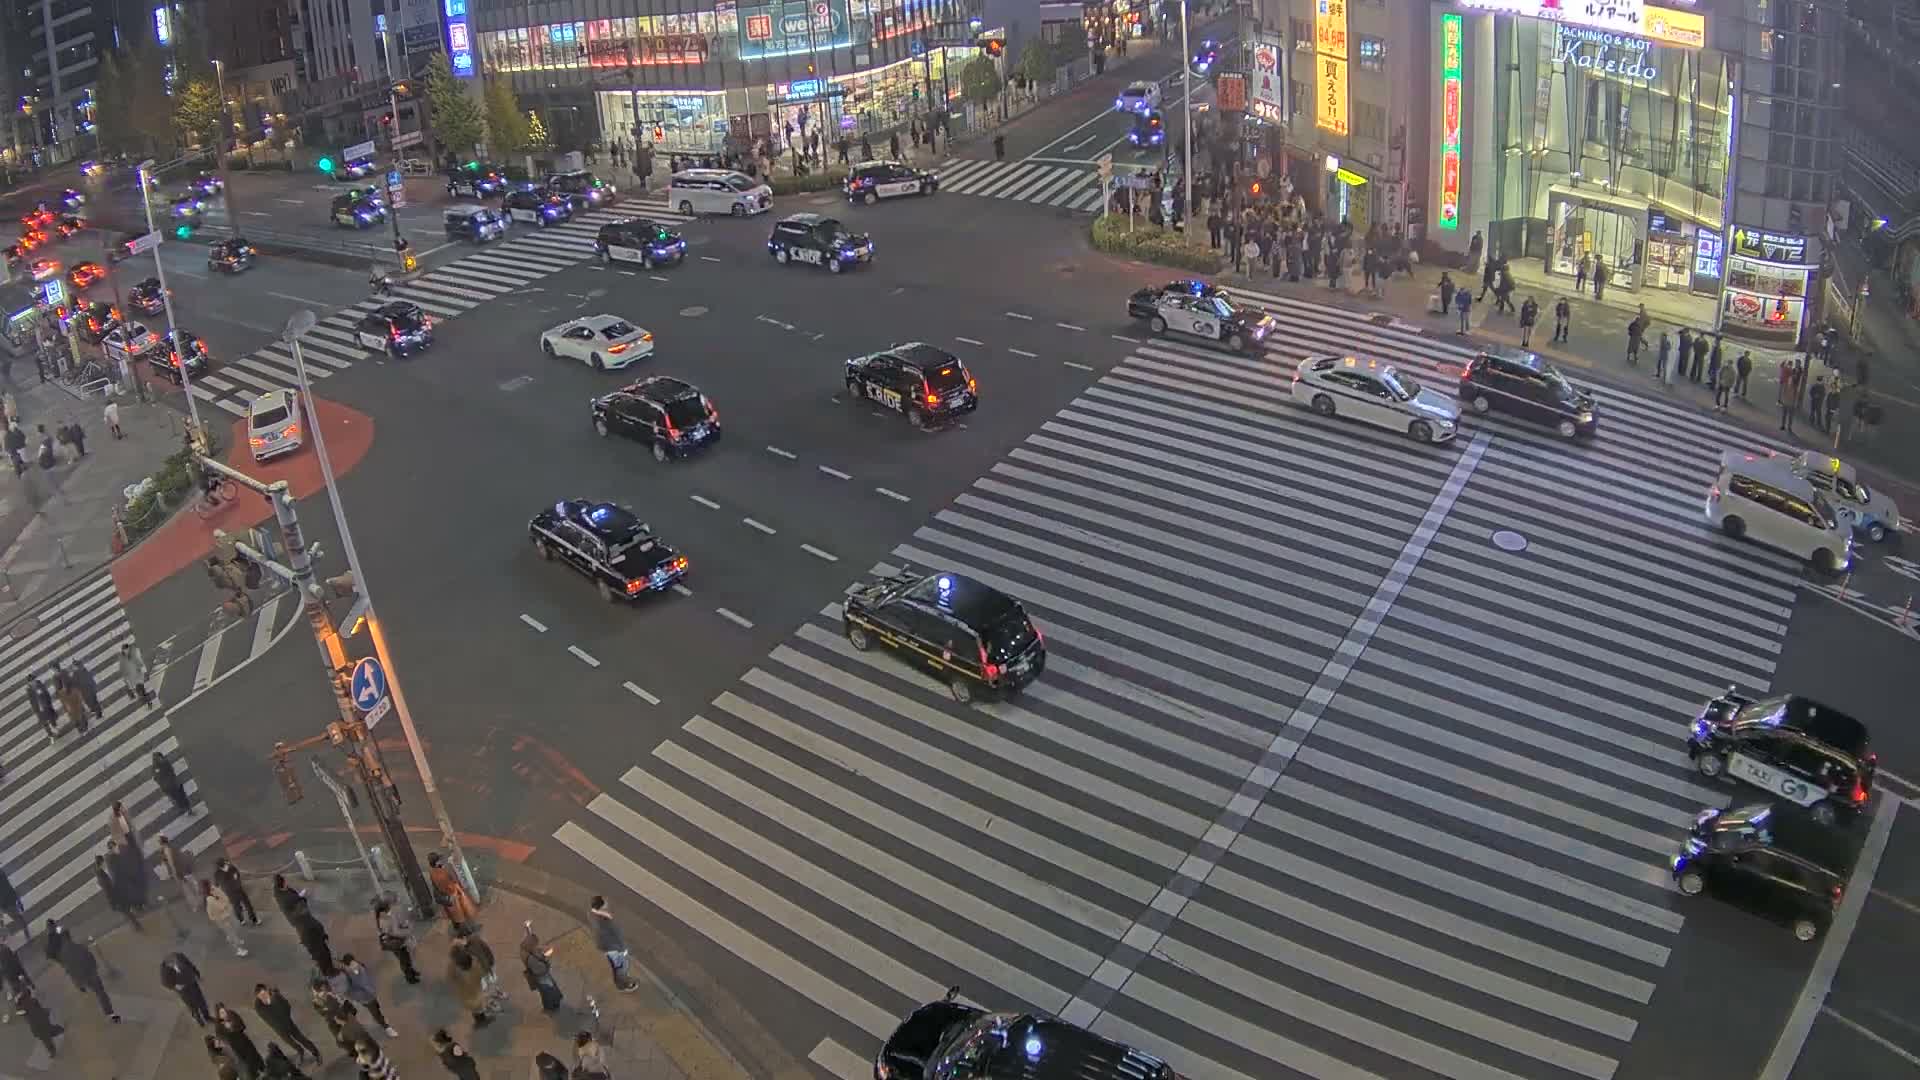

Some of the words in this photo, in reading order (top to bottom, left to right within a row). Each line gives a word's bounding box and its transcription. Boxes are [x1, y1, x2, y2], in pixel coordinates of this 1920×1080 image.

[1585, 5, 1640, 24] ルノアール
[1558, 24, 1612, 44] PACHINKO
[1625, 37, 1653, 51] SLOT
[1561, 38, 1657, 80] Kaleido
